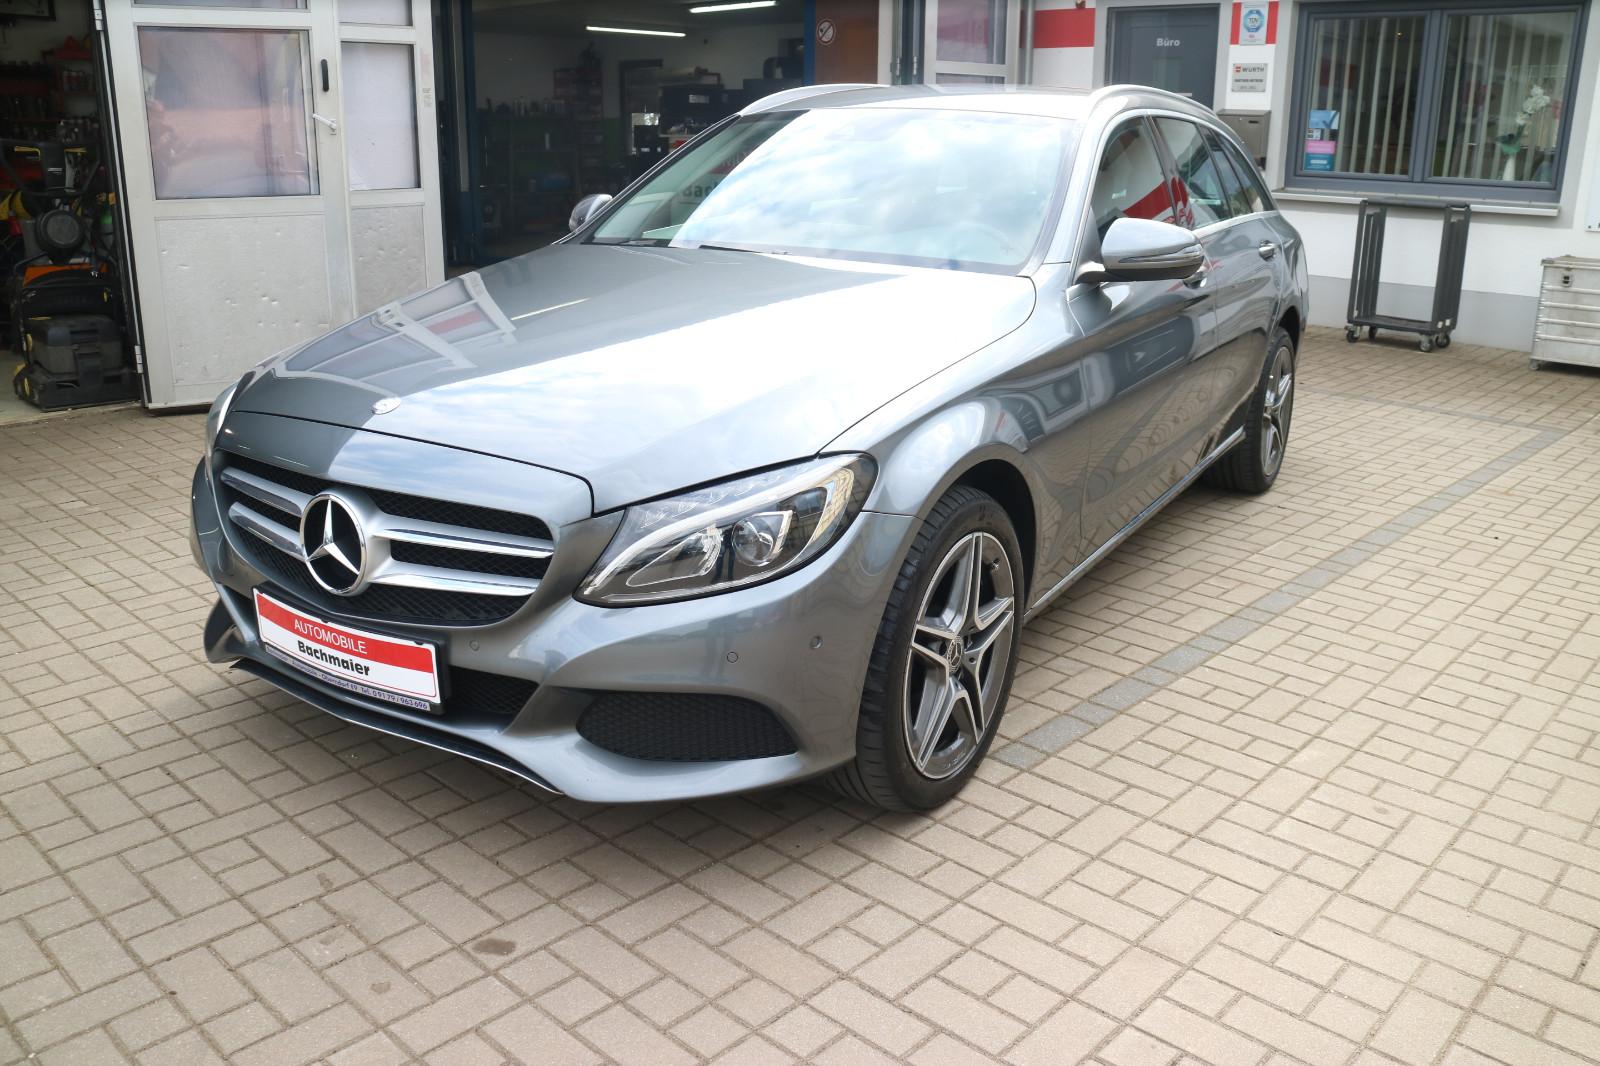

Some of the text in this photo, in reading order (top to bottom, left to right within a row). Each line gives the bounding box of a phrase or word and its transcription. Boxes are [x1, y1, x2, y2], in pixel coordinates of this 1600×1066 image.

[1156, 37, 1181, 47] Büro
[294, 618, 368, 655] AUTOMOBILE
[297, 640, 371, 676] Bachmaier
